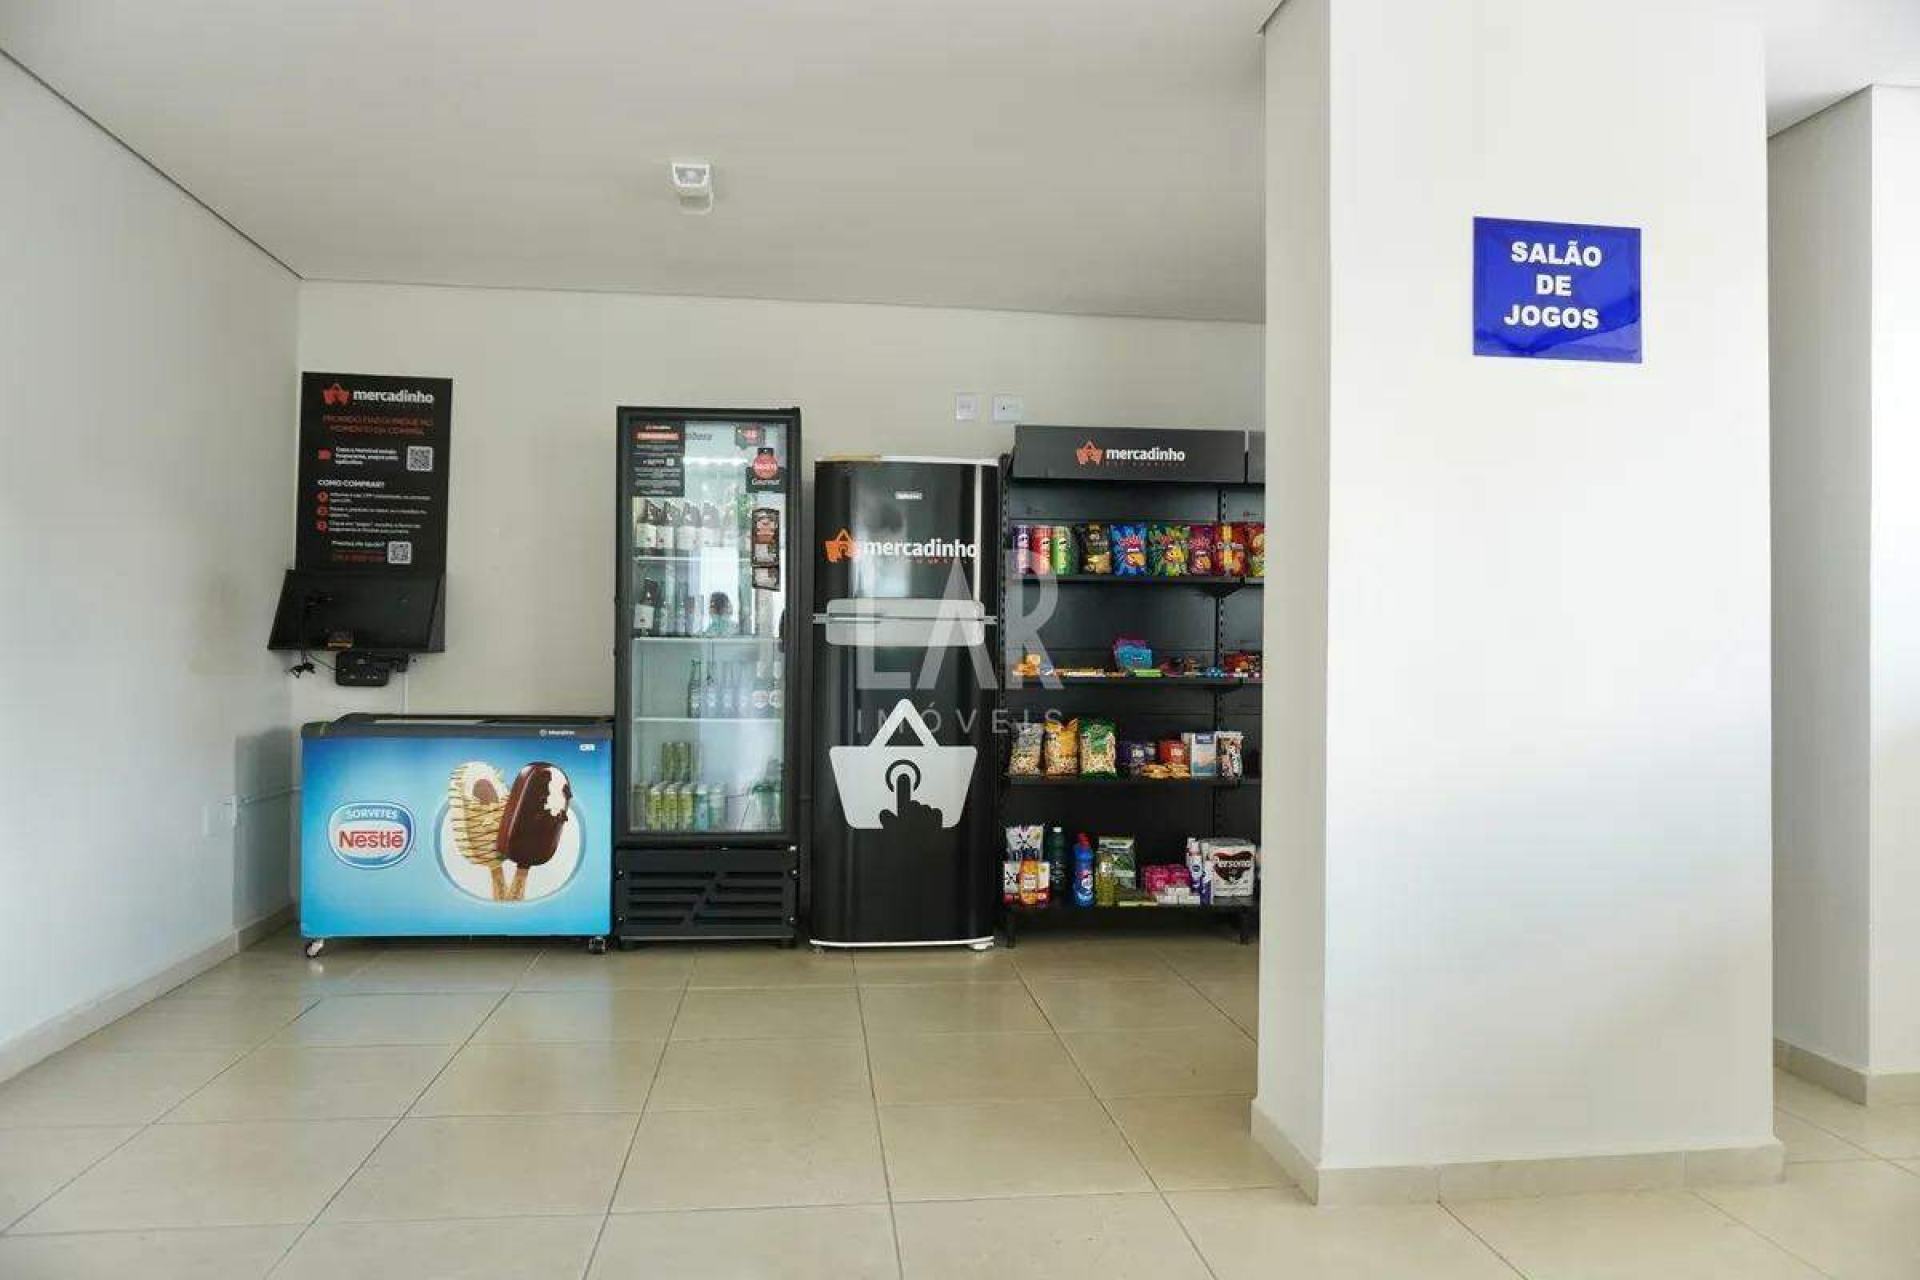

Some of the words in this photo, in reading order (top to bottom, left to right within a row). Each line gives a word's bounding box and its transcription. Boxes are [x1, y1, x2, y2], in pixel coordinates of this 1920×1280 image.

[1510, 239, 1602, 267] SALÃO
[1536, 274, 1572, 296] DE
[1503, 303, 1599, 329] JOGOS
[353, 389, 435, 404] mercadinho
[1106, 447, 1186, 462] mercadinho
[862, 538, 979, 558] mercadinho
[346, 805, 398, 819] SORVETES
[338, 829, 404, 848] Nestlé
